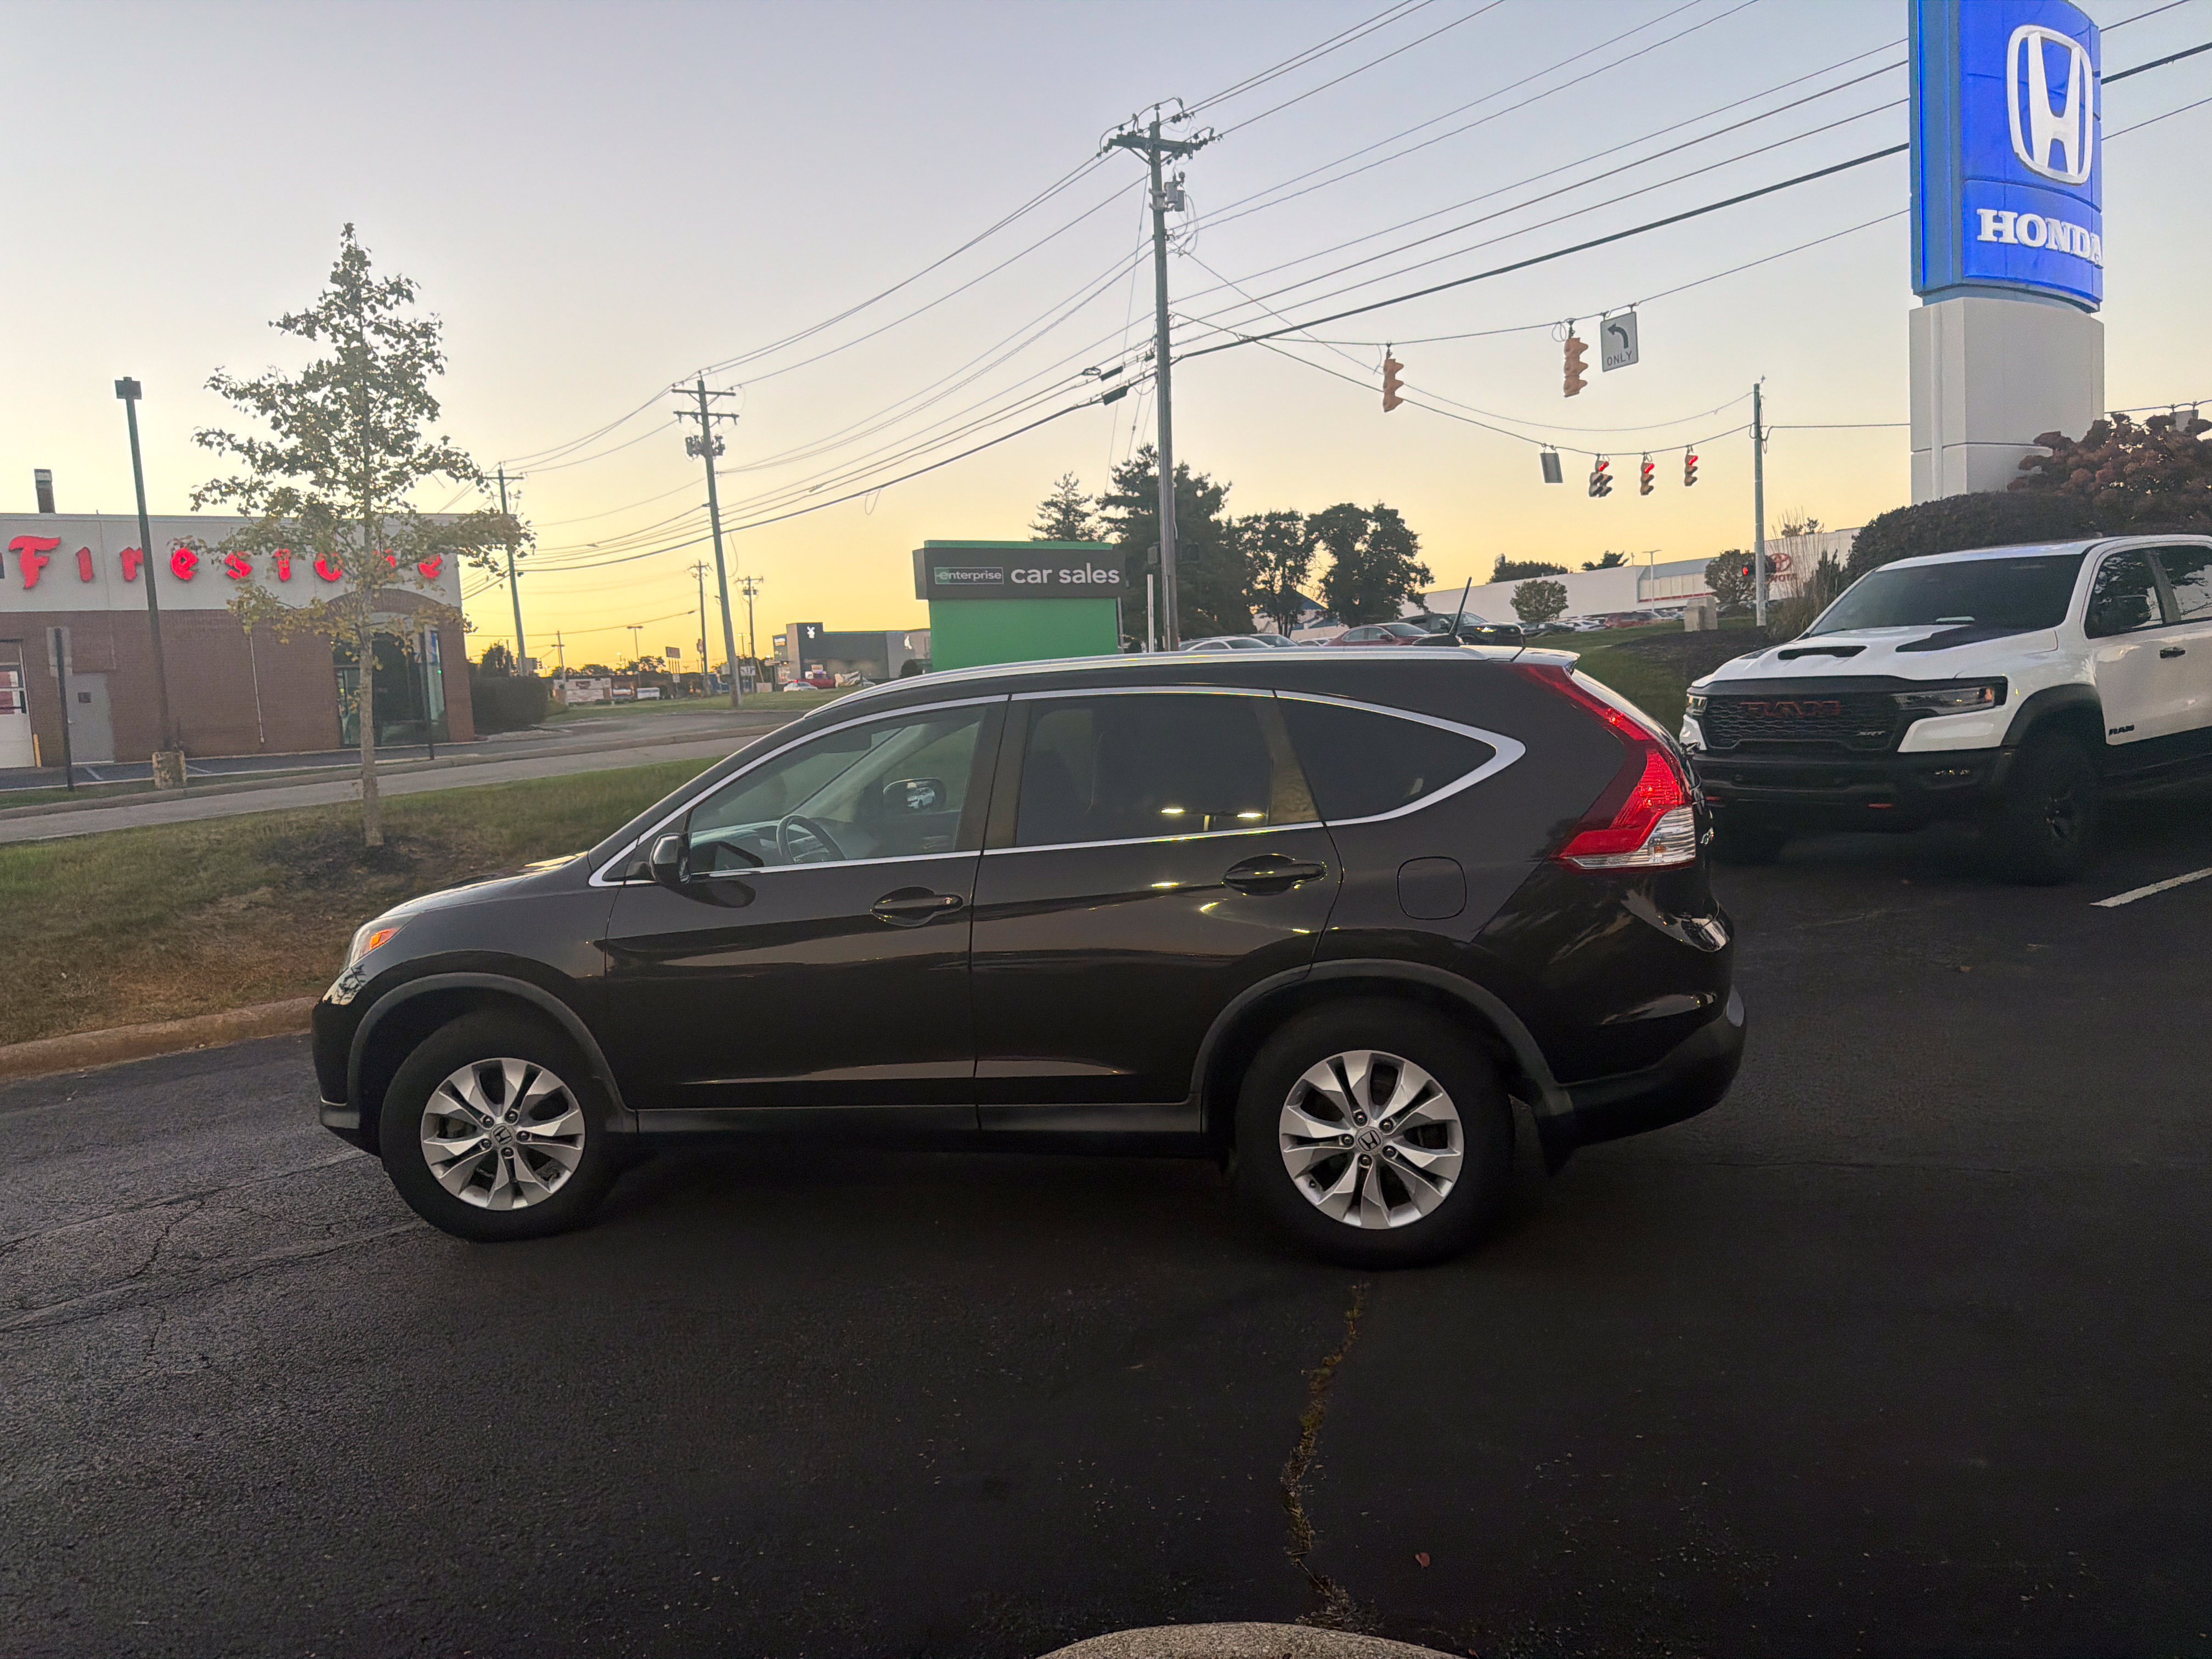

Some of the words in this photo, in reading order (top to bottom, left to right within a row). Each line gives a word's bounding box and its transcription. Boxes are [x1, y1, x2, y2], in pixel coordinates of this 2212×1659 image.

[1977, 208, 2103, 268] HONDA
[1606, 351, 1632, 366] ONLY
[8, 535, 443, 589] Firestoe
[936, 570, 1002, 582] enterprise
[1011, 569, 1053, 584] car
[1059, 562, 1120, 584] sales
[2108, 724, 2135, 736] RAM
